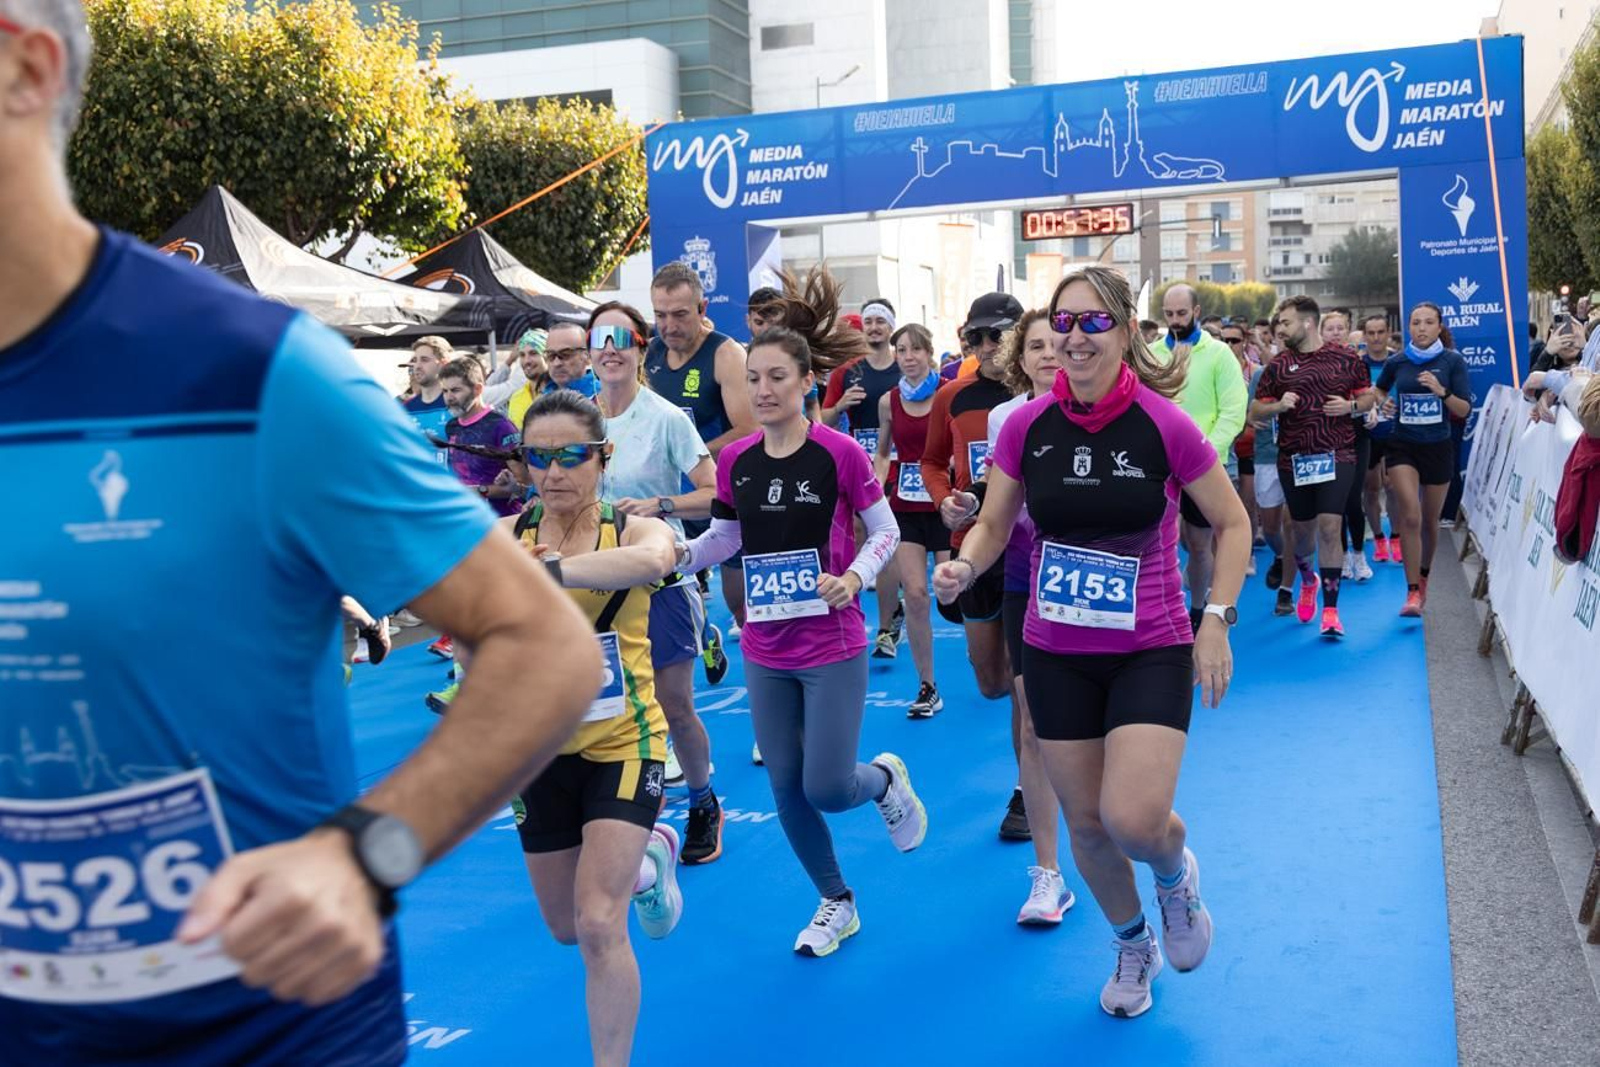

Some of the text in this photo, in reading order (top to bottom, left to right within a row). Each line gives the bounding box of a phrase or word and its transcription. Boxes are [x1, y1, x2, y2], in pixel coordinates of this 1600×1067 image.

[1154, 71, 1267, 102] #DEJAHUELLA
[1405, 78, 1473, 100] MEDIA
[854, 103, 955, 132] #DEJAHUELLA
[1399, 99, 1505, 125] MARATÓN
[1392, 127, 1445, 150] JAÉN
[749, 144, 803, 164] MEDIA
[746, 161, 828, 185] MARATÓN
[740, 187, 783, 207] JAÉN
[1027, 206, 1130, 237] 00:57:35
[1420, 240, 1458, 249] Patronato
[1459, 235, 1497, 246] Municipal
[1430, 247, 1466, 257] Deportes
[1467, 245, 1478, 253] de
[1459, 302, 1504, 316] RURAL
[1403, 401, 1439, 414] 2144
[1297, 459, 1332, 476] 2677
[750, 569, 817, 597] 2456
[1043, 565, 1127, 603] 2153
